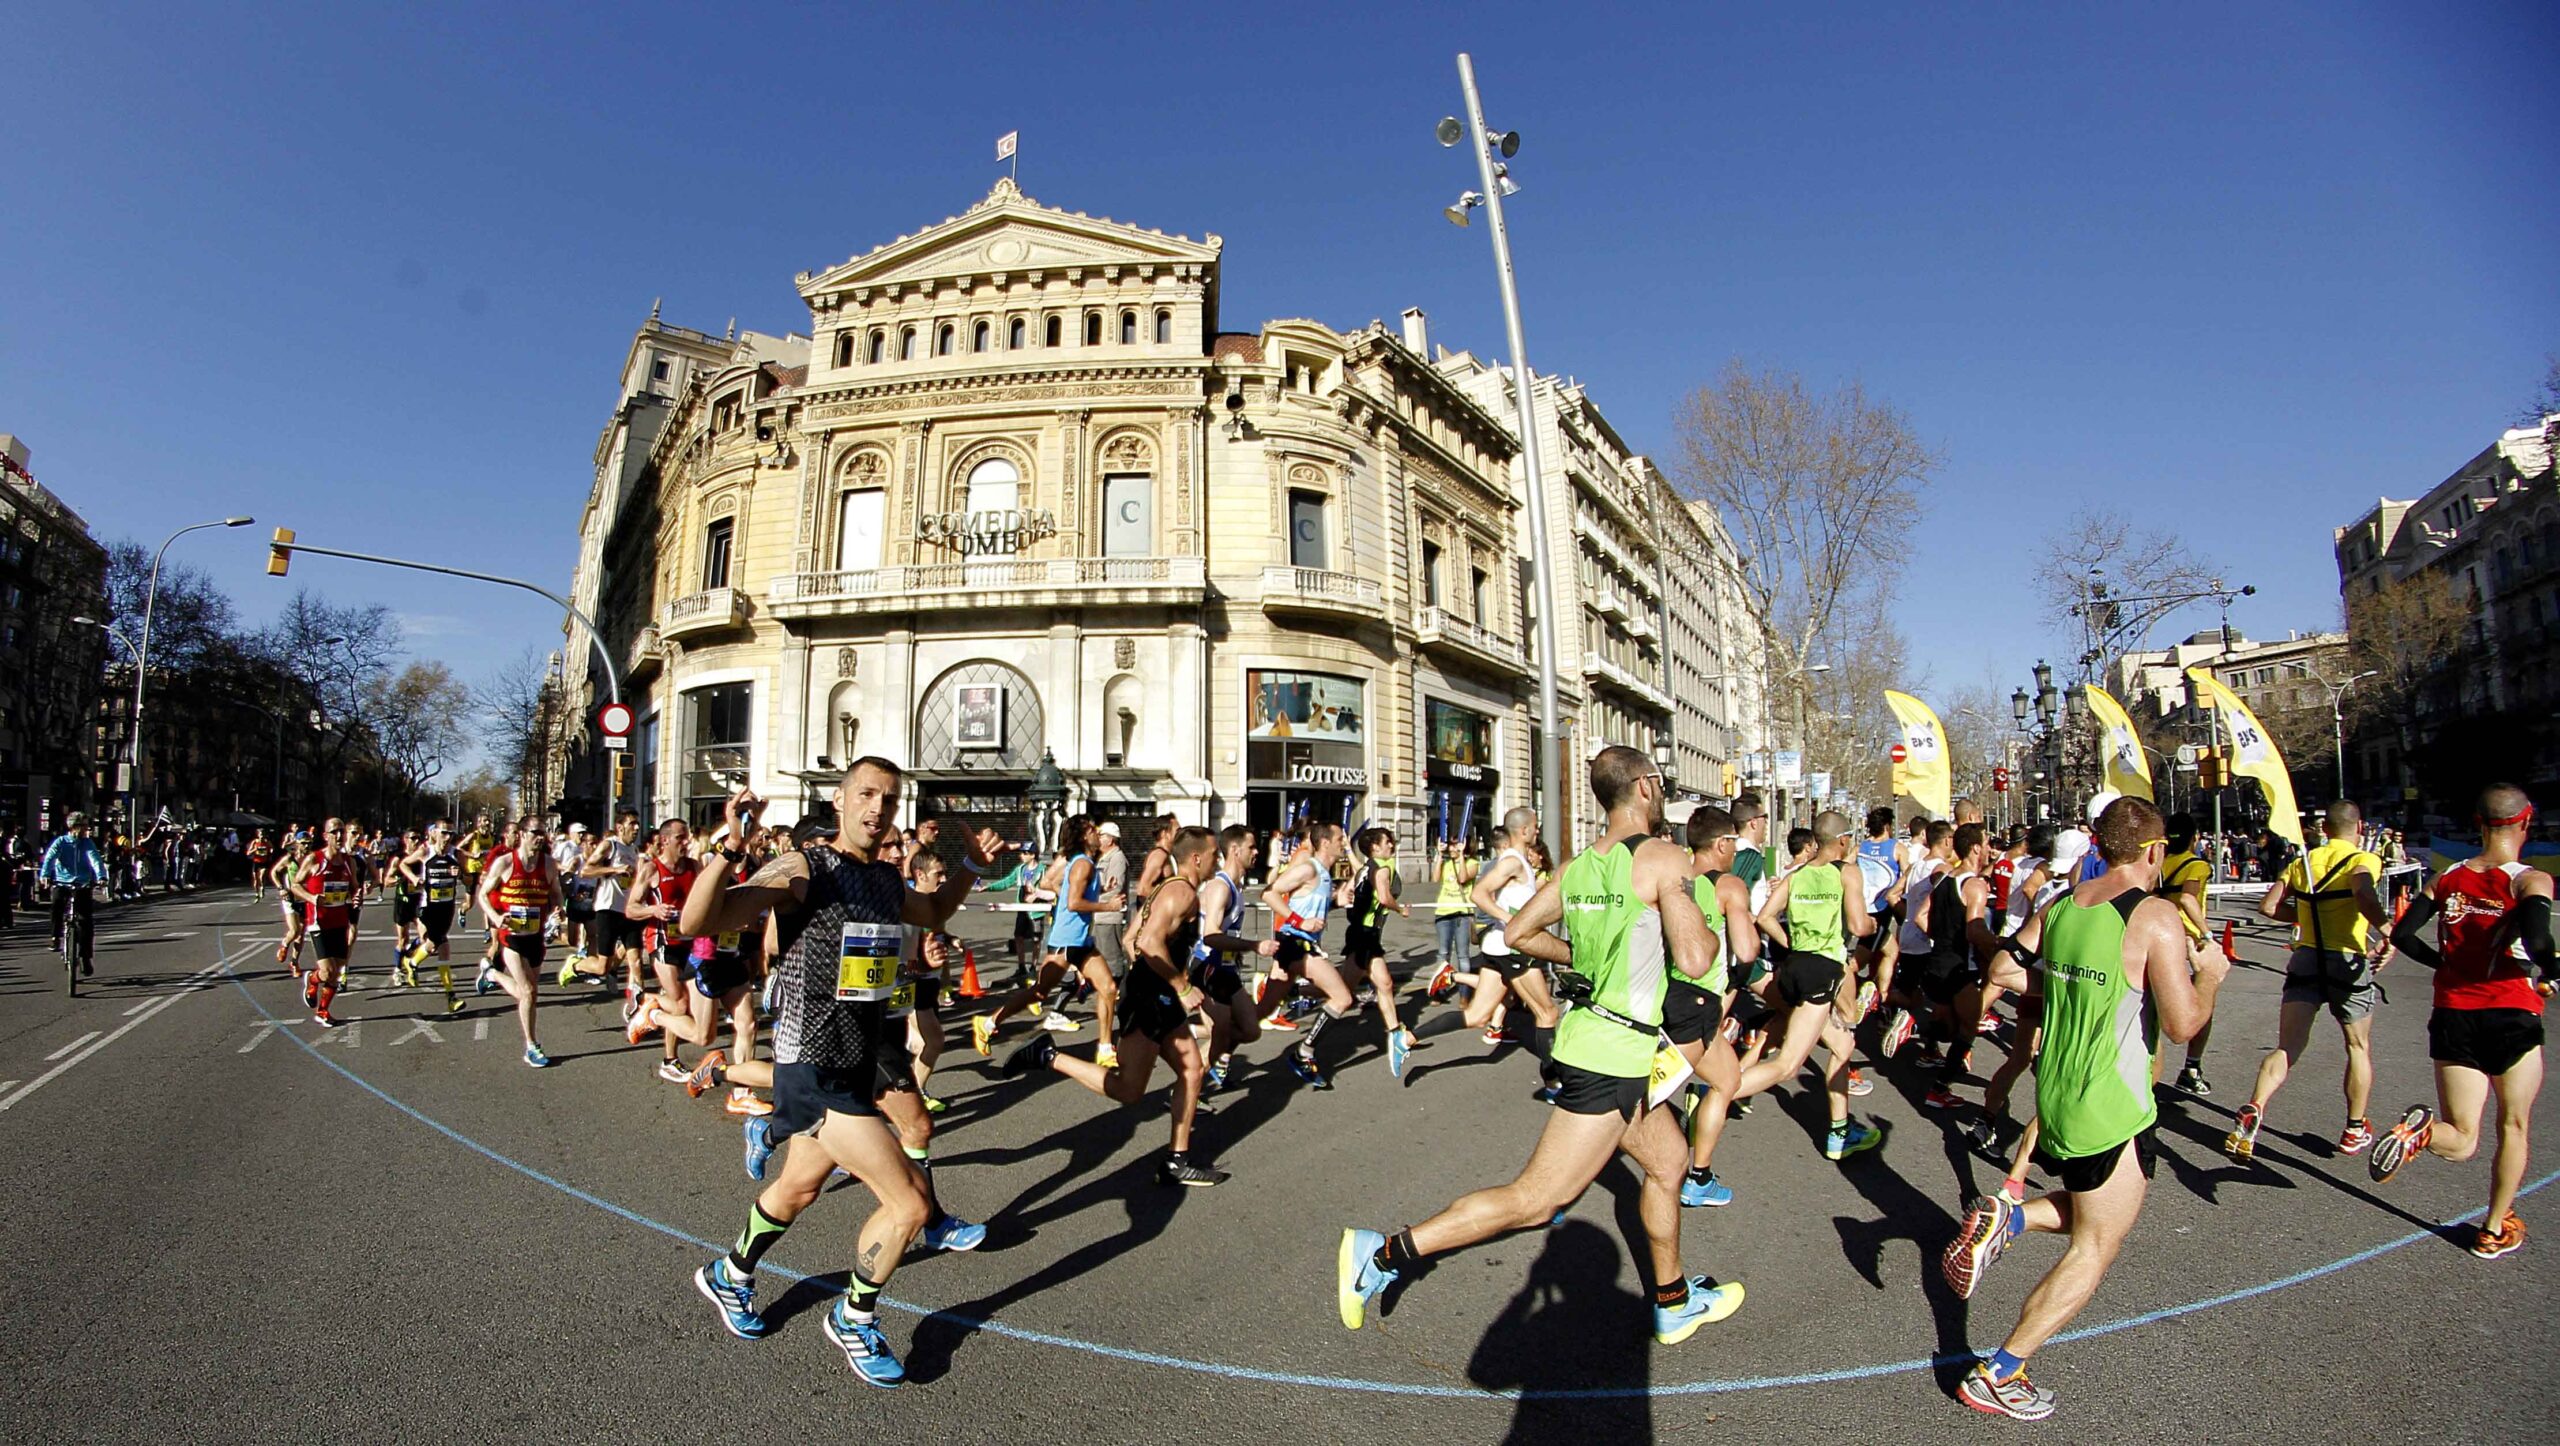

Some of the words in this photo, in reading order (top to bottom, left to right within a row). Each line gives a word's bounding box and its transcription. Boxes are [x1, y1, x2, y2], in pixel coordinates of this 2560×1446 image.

[917, 508, 1056, 537] COMEDIA
[1121, 500, 1140, 523] C
[1298, 519, 1316, 542] C
[1291, 764, 1367, 785] LOTTUSSE
[1585, 893, 1624, 908] running
[2061, 963, 2106, 986] running
[238, 1016, 489, 1053] TAXI
